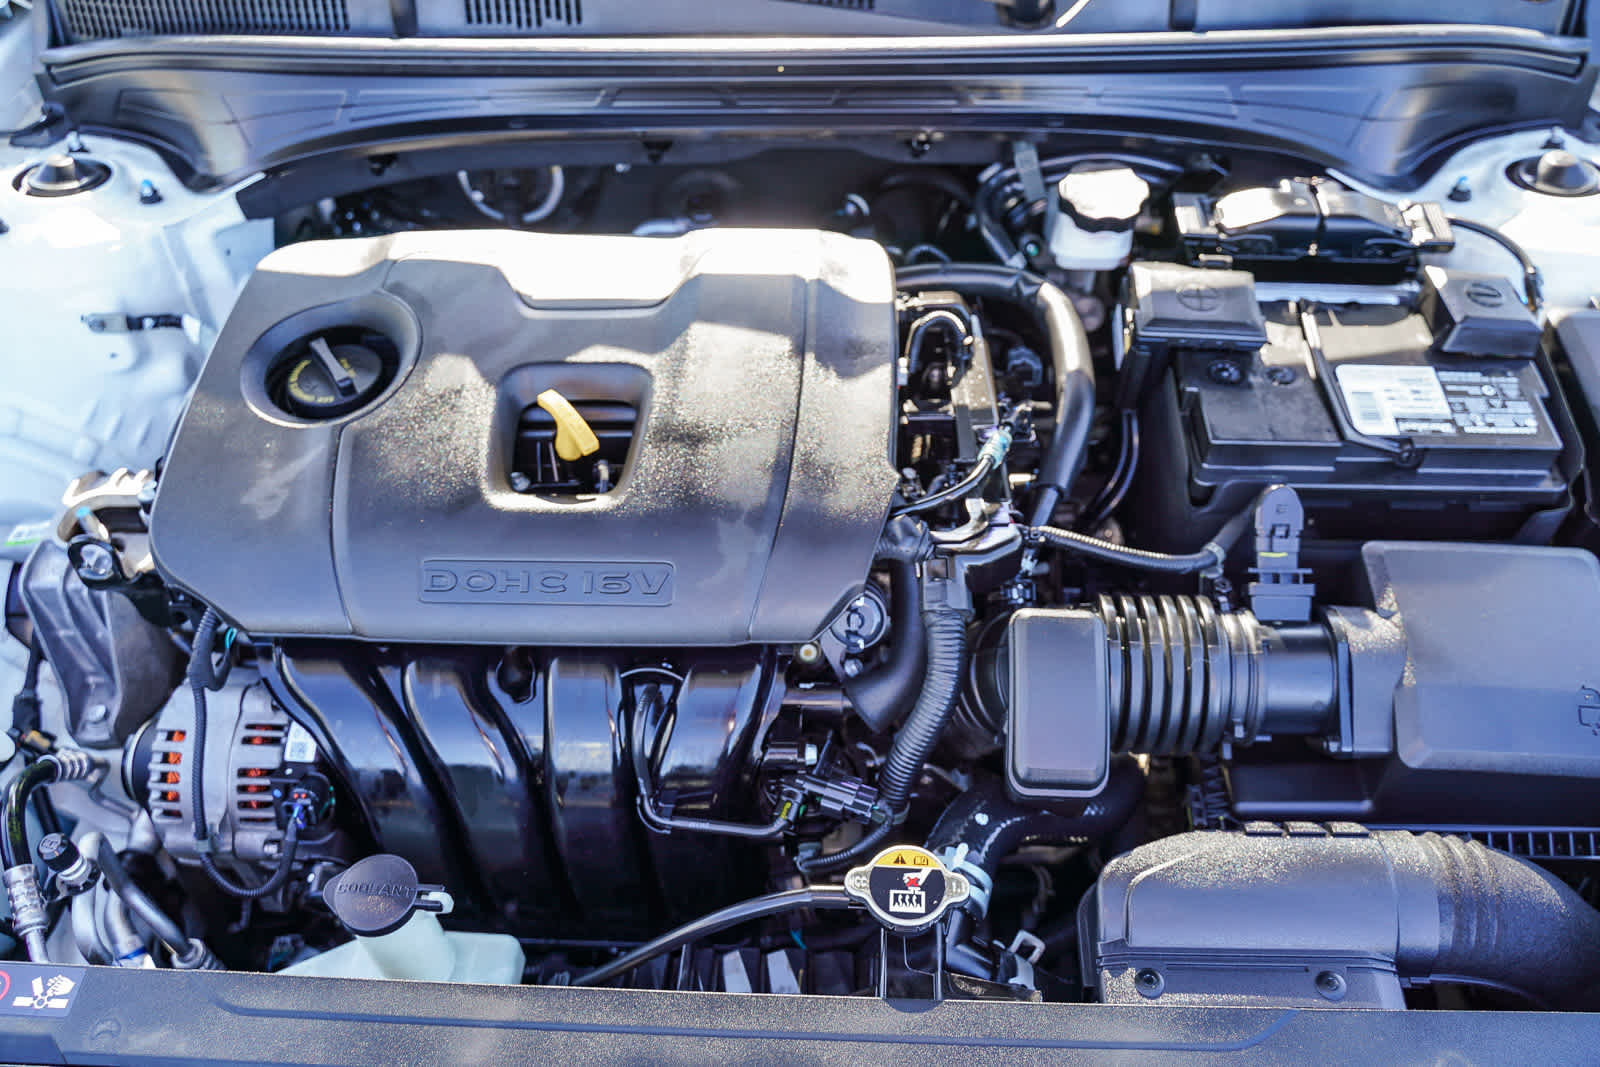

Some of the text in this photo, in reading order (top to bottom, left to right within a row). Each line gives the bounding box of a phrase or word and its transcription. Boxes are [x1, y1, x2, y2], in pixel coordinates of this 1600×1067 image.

[423, 569, 670, 595] DOHC 16V
[337, 881, 413, 898] COOLANT
